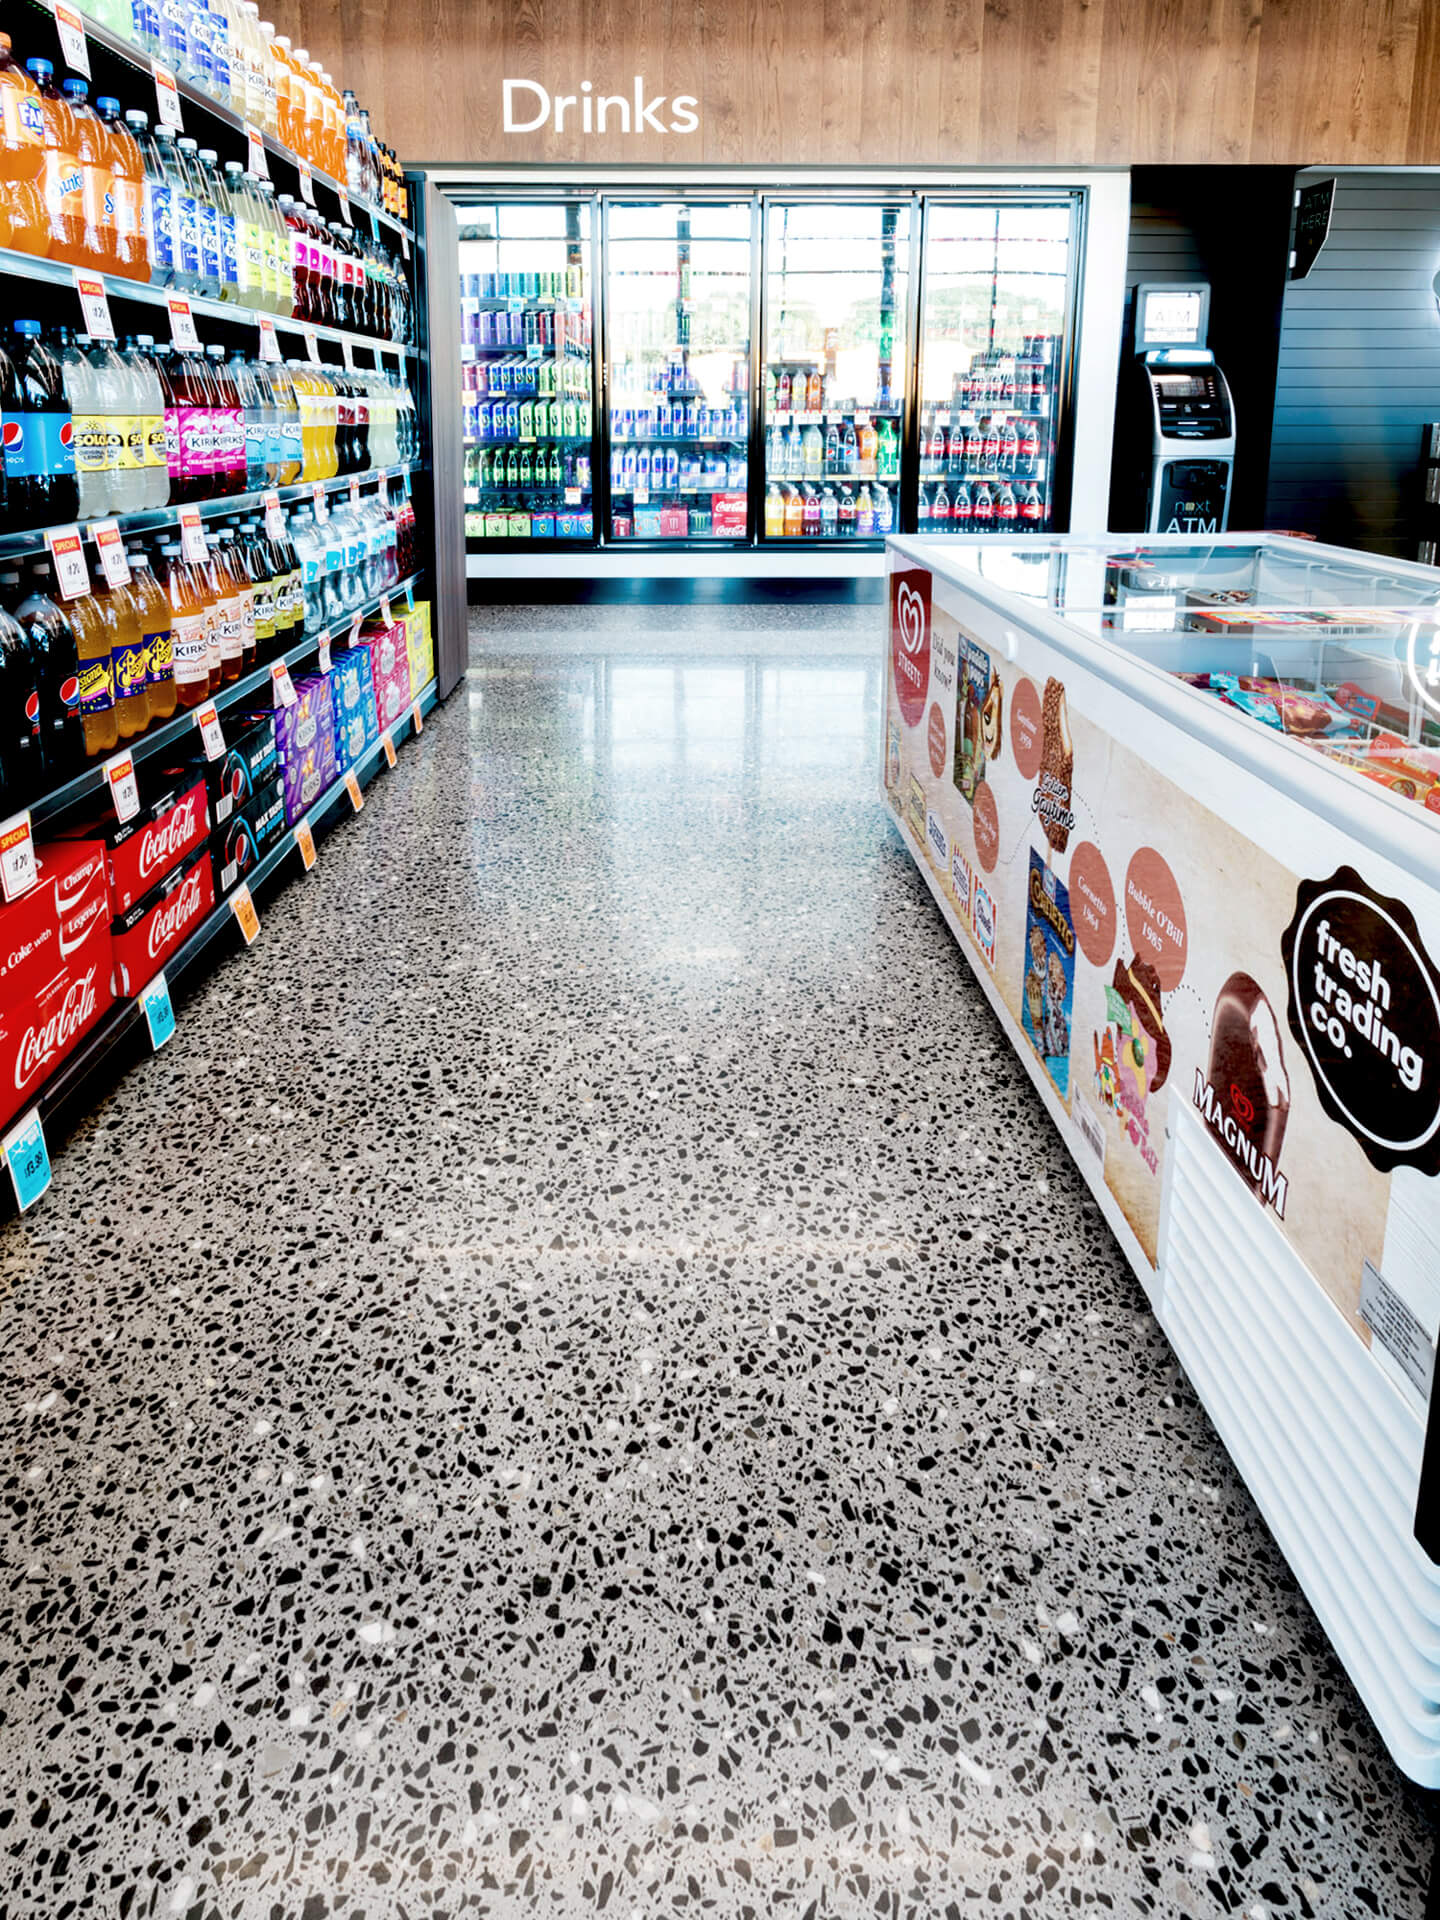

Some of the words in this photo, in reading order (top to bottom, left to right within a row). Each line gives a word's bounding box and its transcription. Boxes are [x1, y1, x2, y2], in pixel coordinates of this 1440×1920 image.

[502, 76, 700, 133] Drinks
[55, 538, 78, 553] SPECIAL
[1165, 517, 1218, 533] ATM
[898, 650, 921, 688] STREETS
[1031, 788, 1075, 830] Gaytime
[1, 826, 28, 849] SPECIAL
[140, 796, 196, 878] Coca-Cola
[63, 863, 93, 890] Champ
[1078, 875, 1107, 916] Cornetto
[68, 900, 98, 934] Legend
[149, 868, 202, 958] Coca-Cola
[1127, 880, 1155, 918] Bubble
[1156, 911, 1184, 948] O'Bill
[8, 942, 34, 969] Coke
[1142, 921, 1163, 952] 1985
[1316, 919, 1391, 1011] fresh
[15, 963, 97, 1090] Coca-Cola
[1310, 1001, 1353, 1059] co.
[1313, 960, 1424, 1092] trading
[1192, 1067, 1289, 1221] MAGNUM
